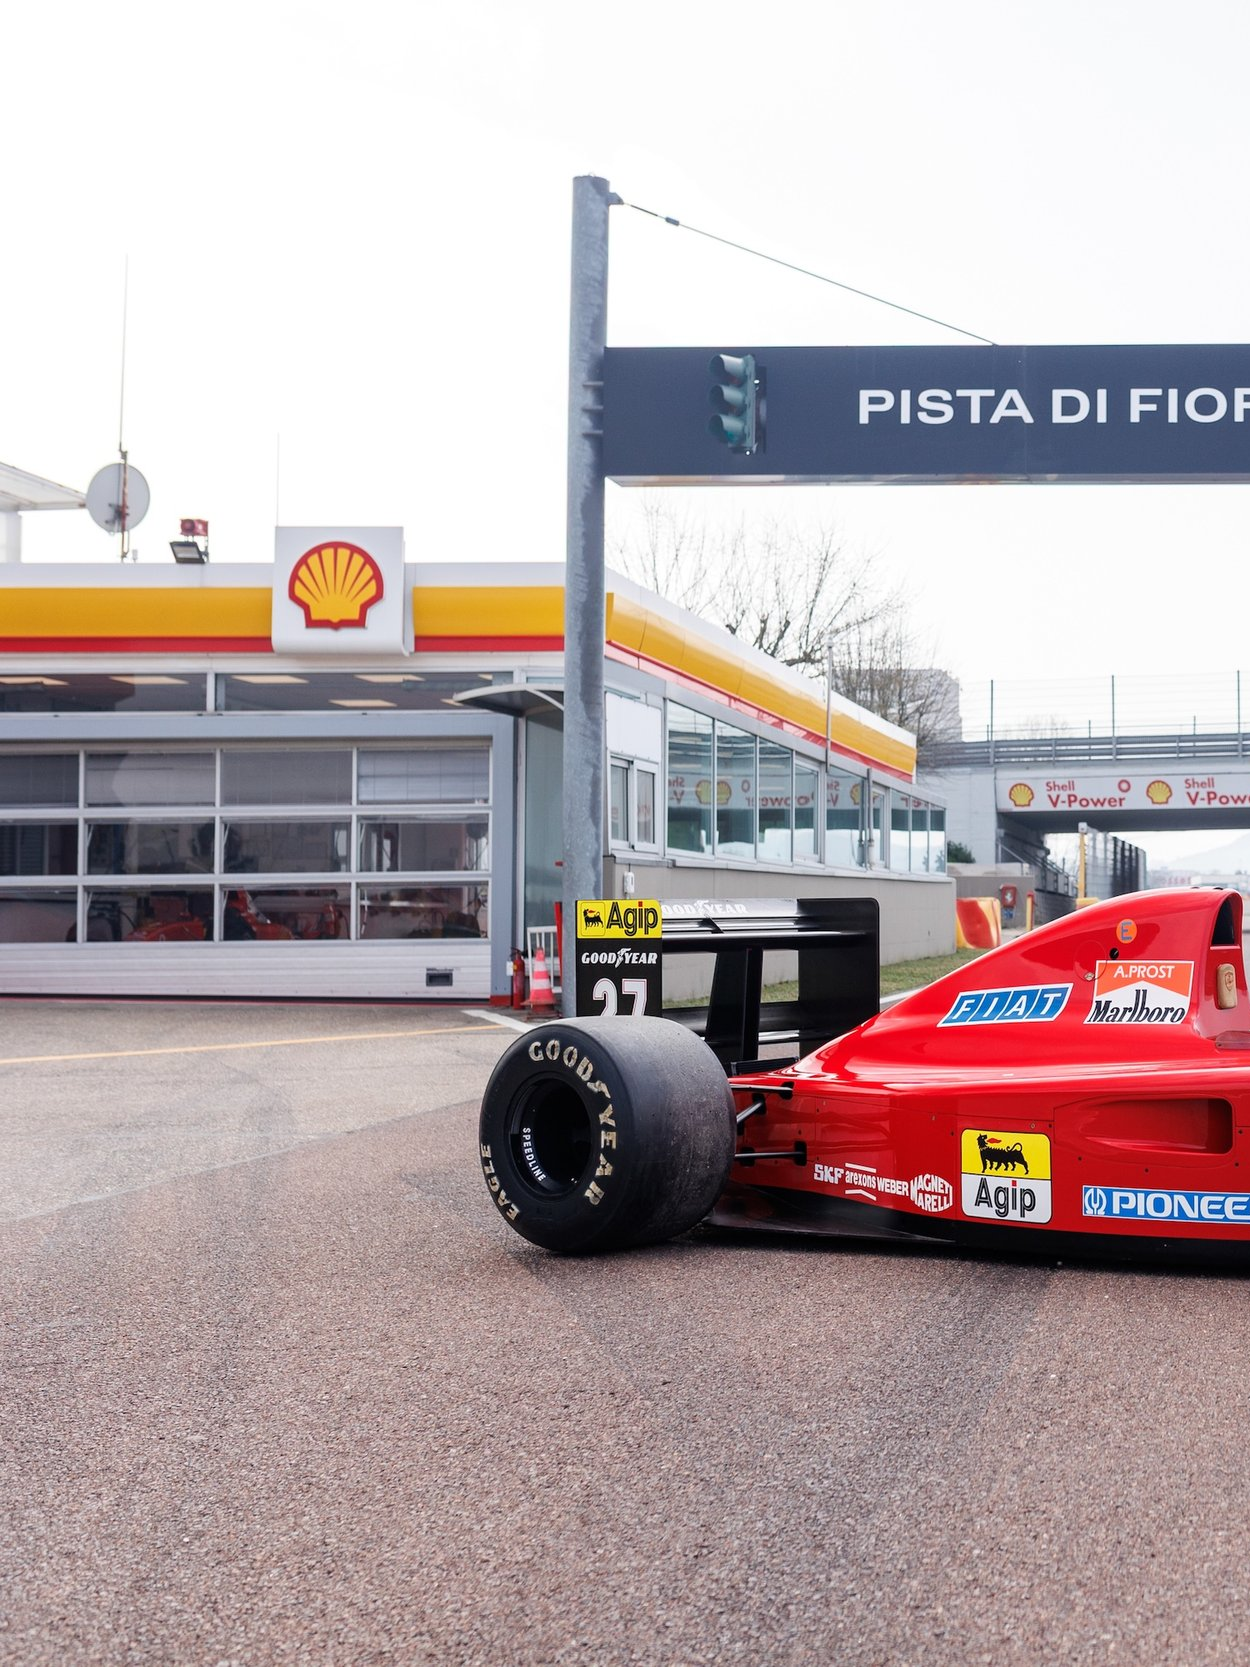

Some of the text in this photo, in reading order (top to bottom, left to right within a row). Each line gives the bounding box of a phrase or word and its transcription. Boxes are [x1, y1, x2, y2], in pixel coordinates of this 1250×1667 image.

[858, 388, 1034, 425] PISTA
[1052, 388, 1109, 424] DI
[1045, 780, 1075, 792] Shell
[1184, 777, 1215, 790] Shell
[1047, 794, 1126, 808] V-Power
[606, 901, 659, 936] Agip
[659, 901, 749, 916] OODYEAR
[581, 947, 658, 968] GOODYEAR
[1113, 965, 1175, 979] A.PROST
[592, 977, 648, 1017] 27
[955, 993, 1064, 1019] FIAT
[1087, 989, 1185, 1023] Marlboro
[528, 1039, 617, 1206] GOODYEAR
[522, 1127, 547, 1182] SPEEDLINE
[480, 1143, 521, 1221] EAGLE
[813, 1163, 909, 1197] SKF arexons WEBER
[974, 1177, 1036, 1218] Agip
